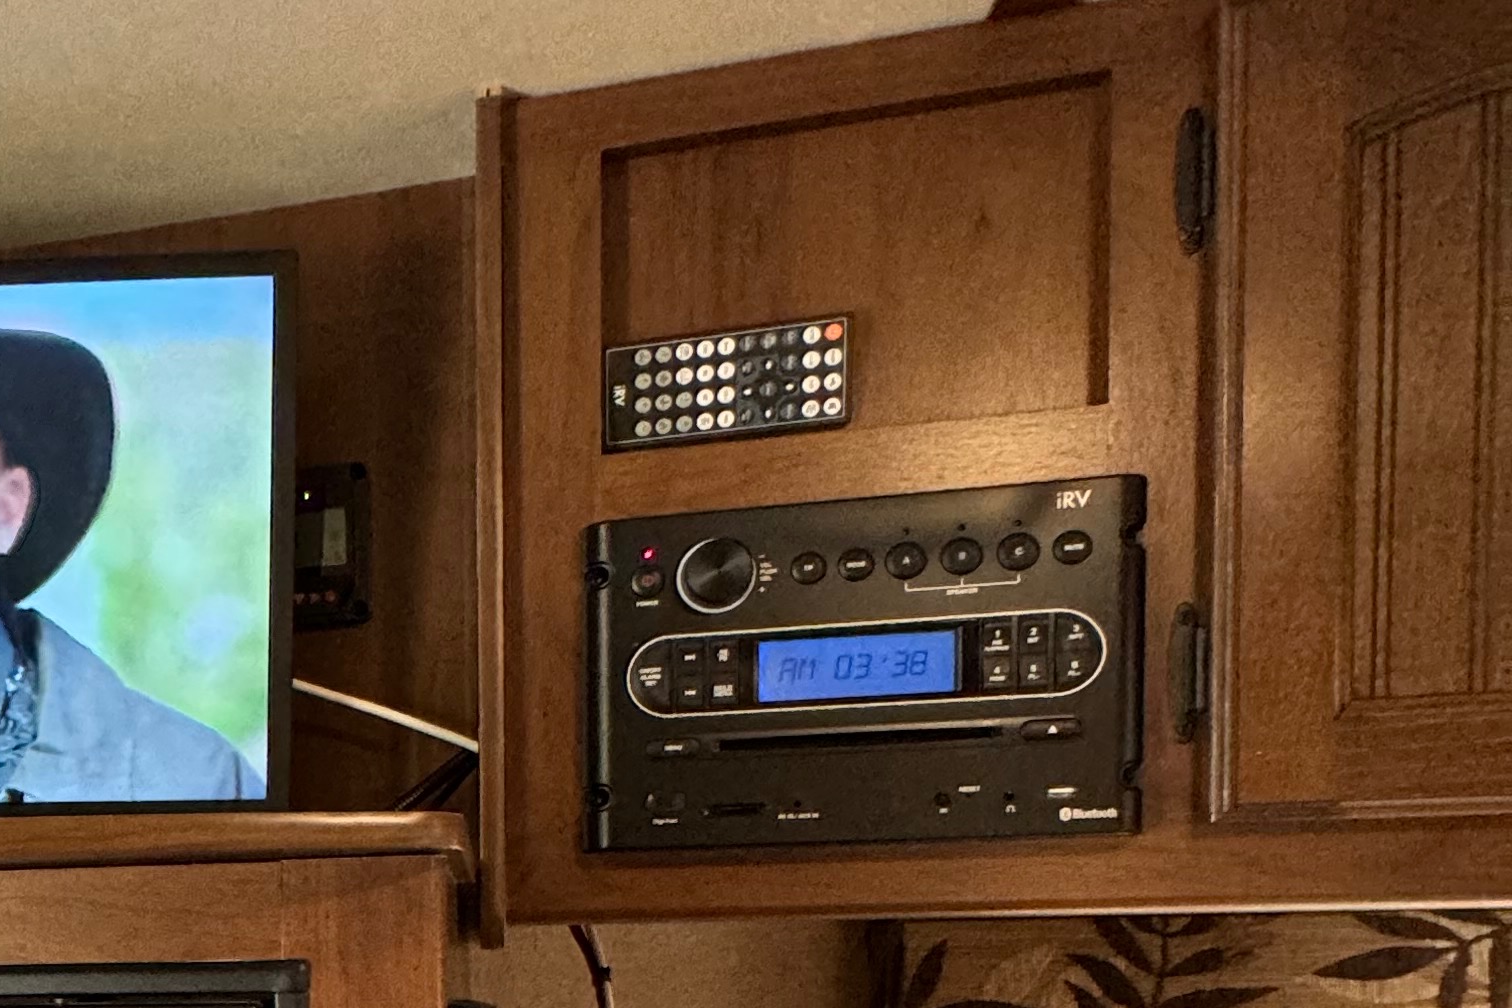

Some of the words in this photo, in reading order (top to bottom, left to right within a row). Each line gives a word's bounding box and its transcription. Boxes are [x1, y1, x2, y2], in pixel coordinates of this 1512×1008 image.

[1056, 489, 1092, 510] iRV
[902, 556, 910, 565] A
[778, 656, 816, 684] AM
